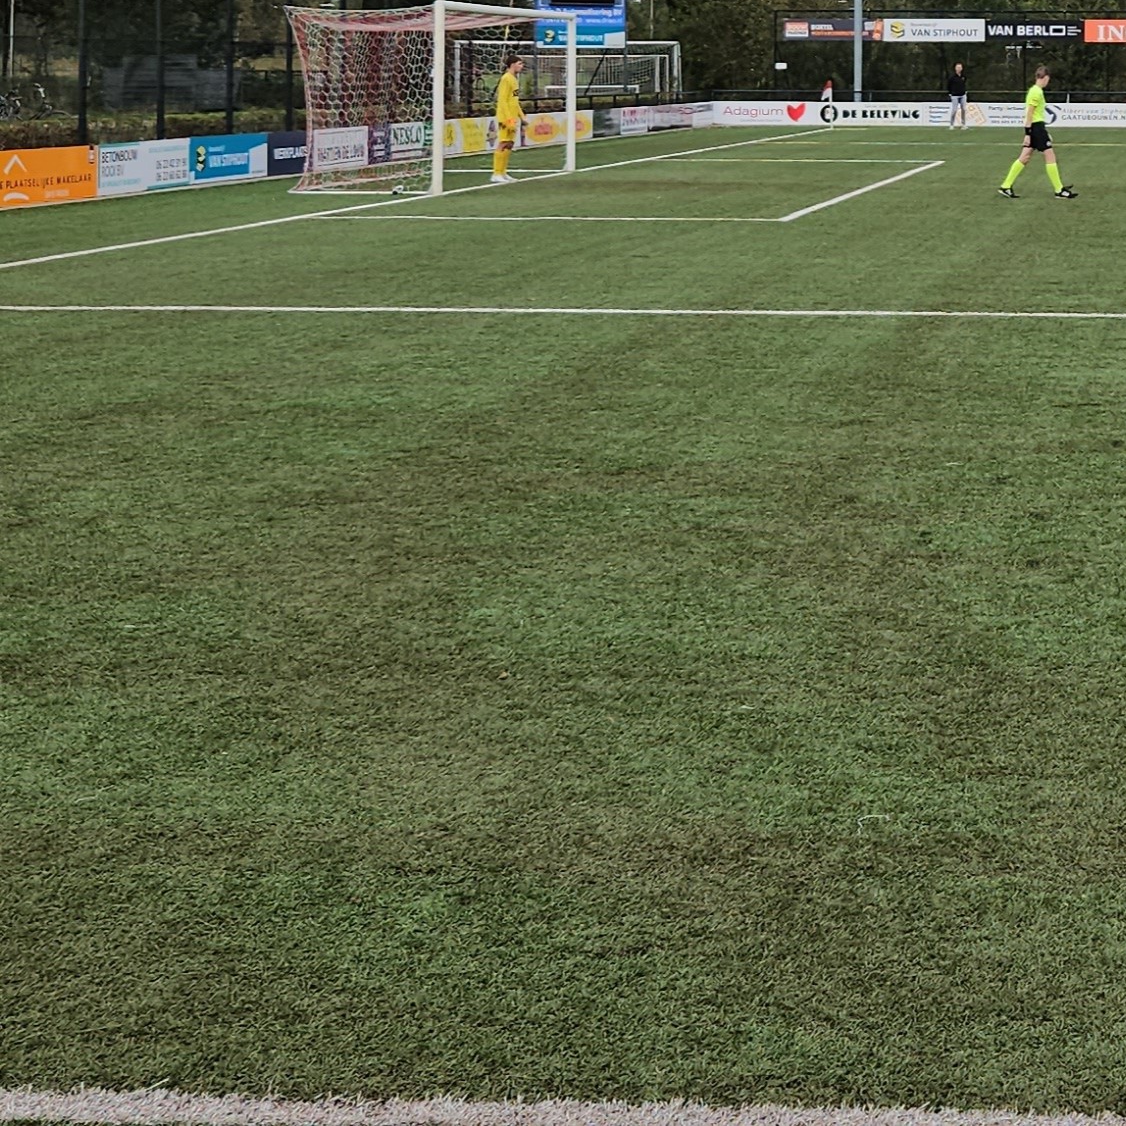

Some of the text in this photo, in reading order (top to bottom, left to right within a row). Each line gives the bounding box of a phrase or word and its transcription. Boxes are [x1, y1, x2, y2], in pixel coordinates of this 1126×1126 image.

[988, 25, 1013, 36] VAN
[723, 106, 784, 118] Adagium
[842, 110, 857, 118] DE
[862, 110, 920, 119] BELEVING
[102, 149, 138, 164] BETONBOUW
[56, 173, 92, 185] MAKELAAR
